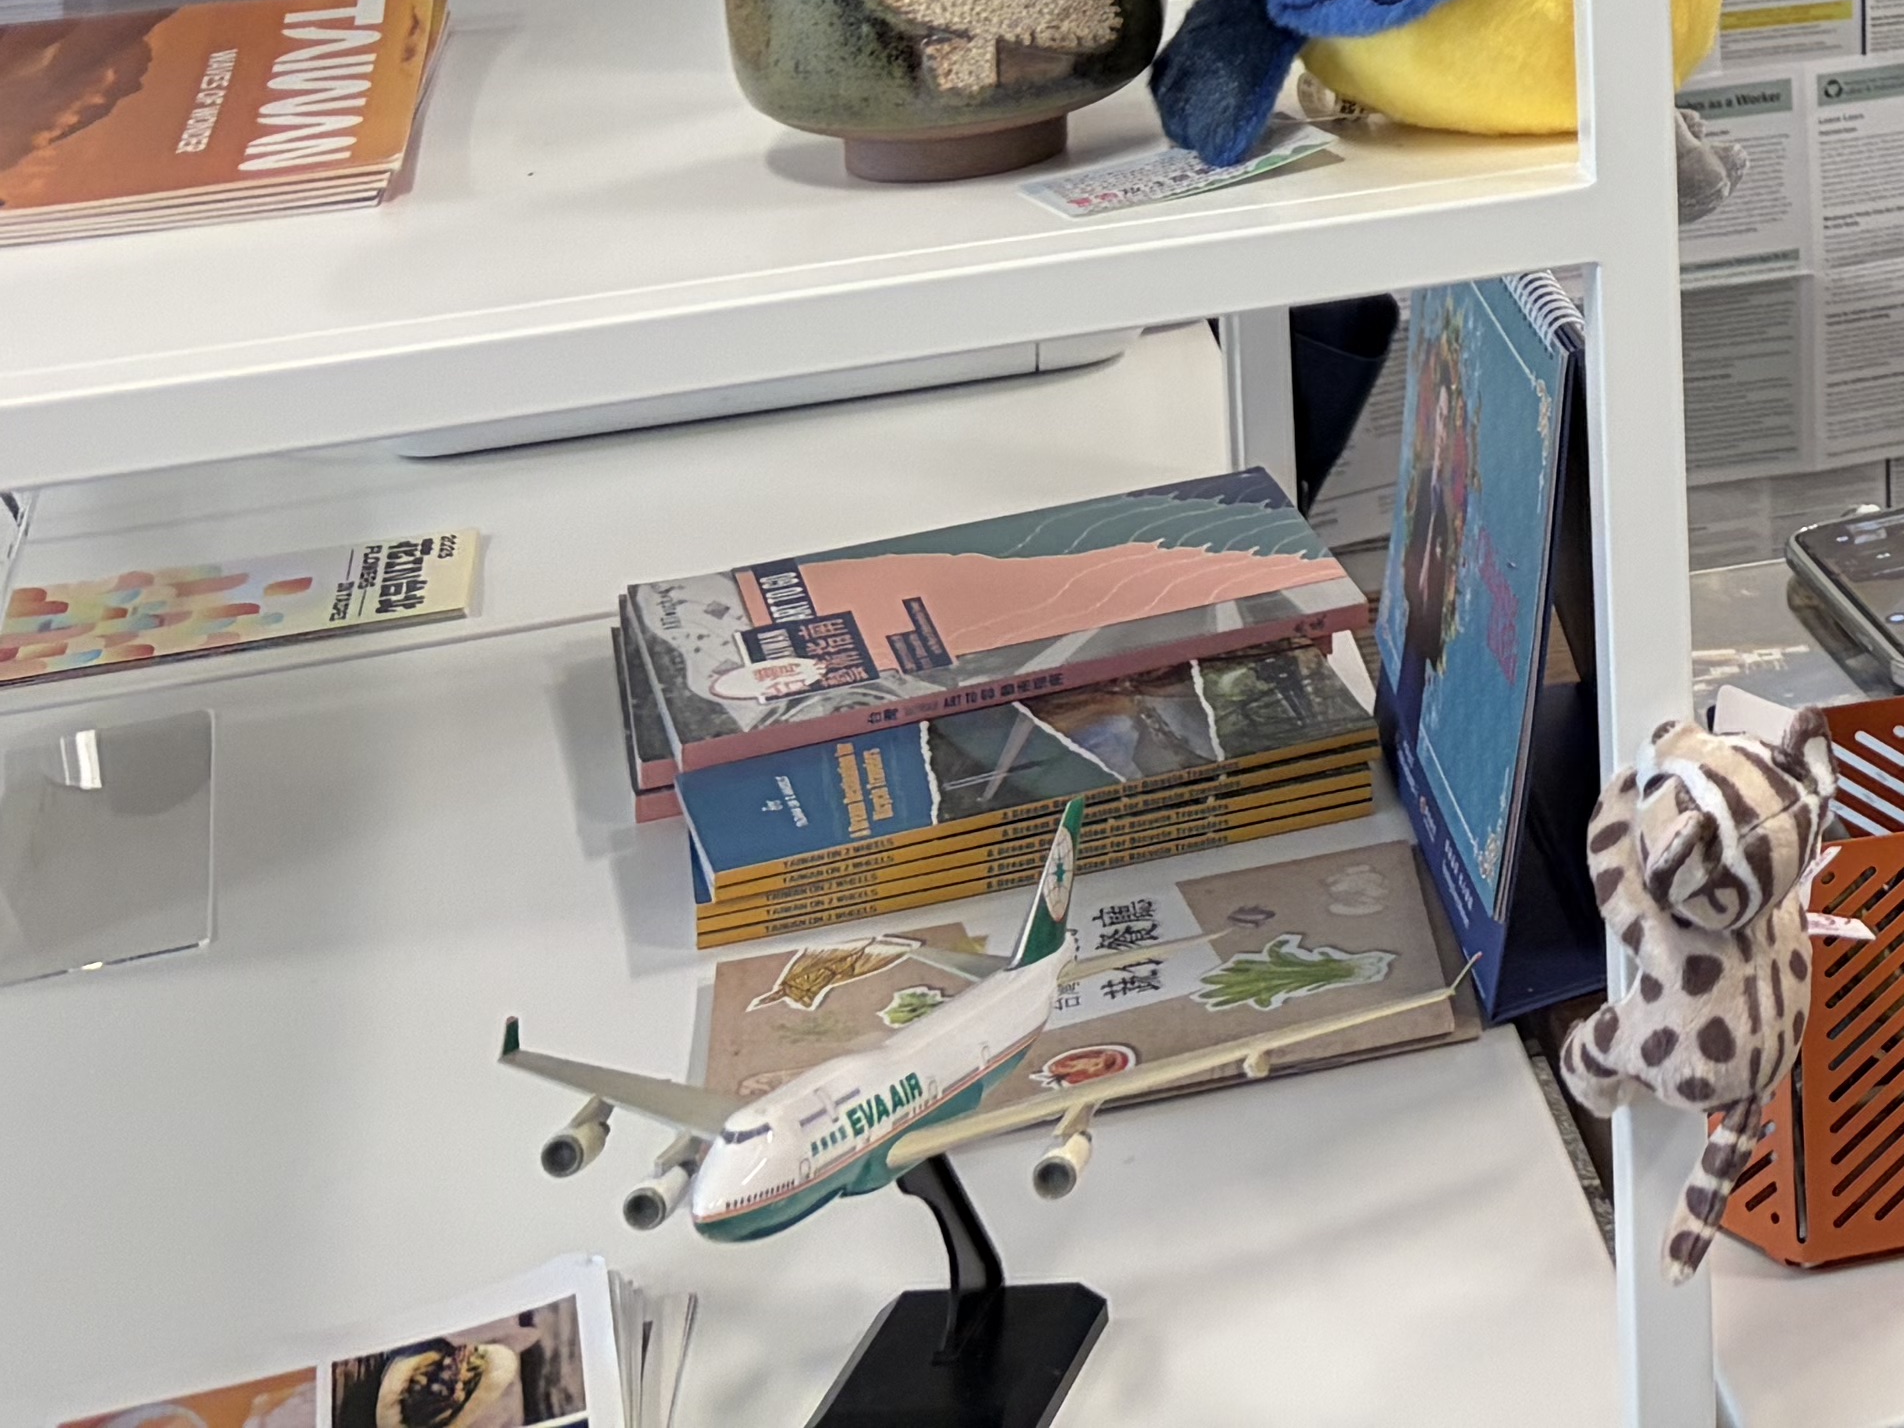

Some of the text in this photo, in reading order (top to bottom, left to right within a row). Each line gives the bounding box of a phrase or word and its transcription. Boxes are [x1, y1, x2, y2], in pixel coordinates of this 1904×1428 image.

[175, 48, 238, 155] WAVES OF WONDER
[1737, 91, 1783, 107] Worker
[358, 544, 383, 590] FLOWERS
[759, 572, 816, 624] ART TO GO
[1091, 898, 1159, 1002] 蔬餐廳
[851, 1072, 923, 1136] EVA AIR
